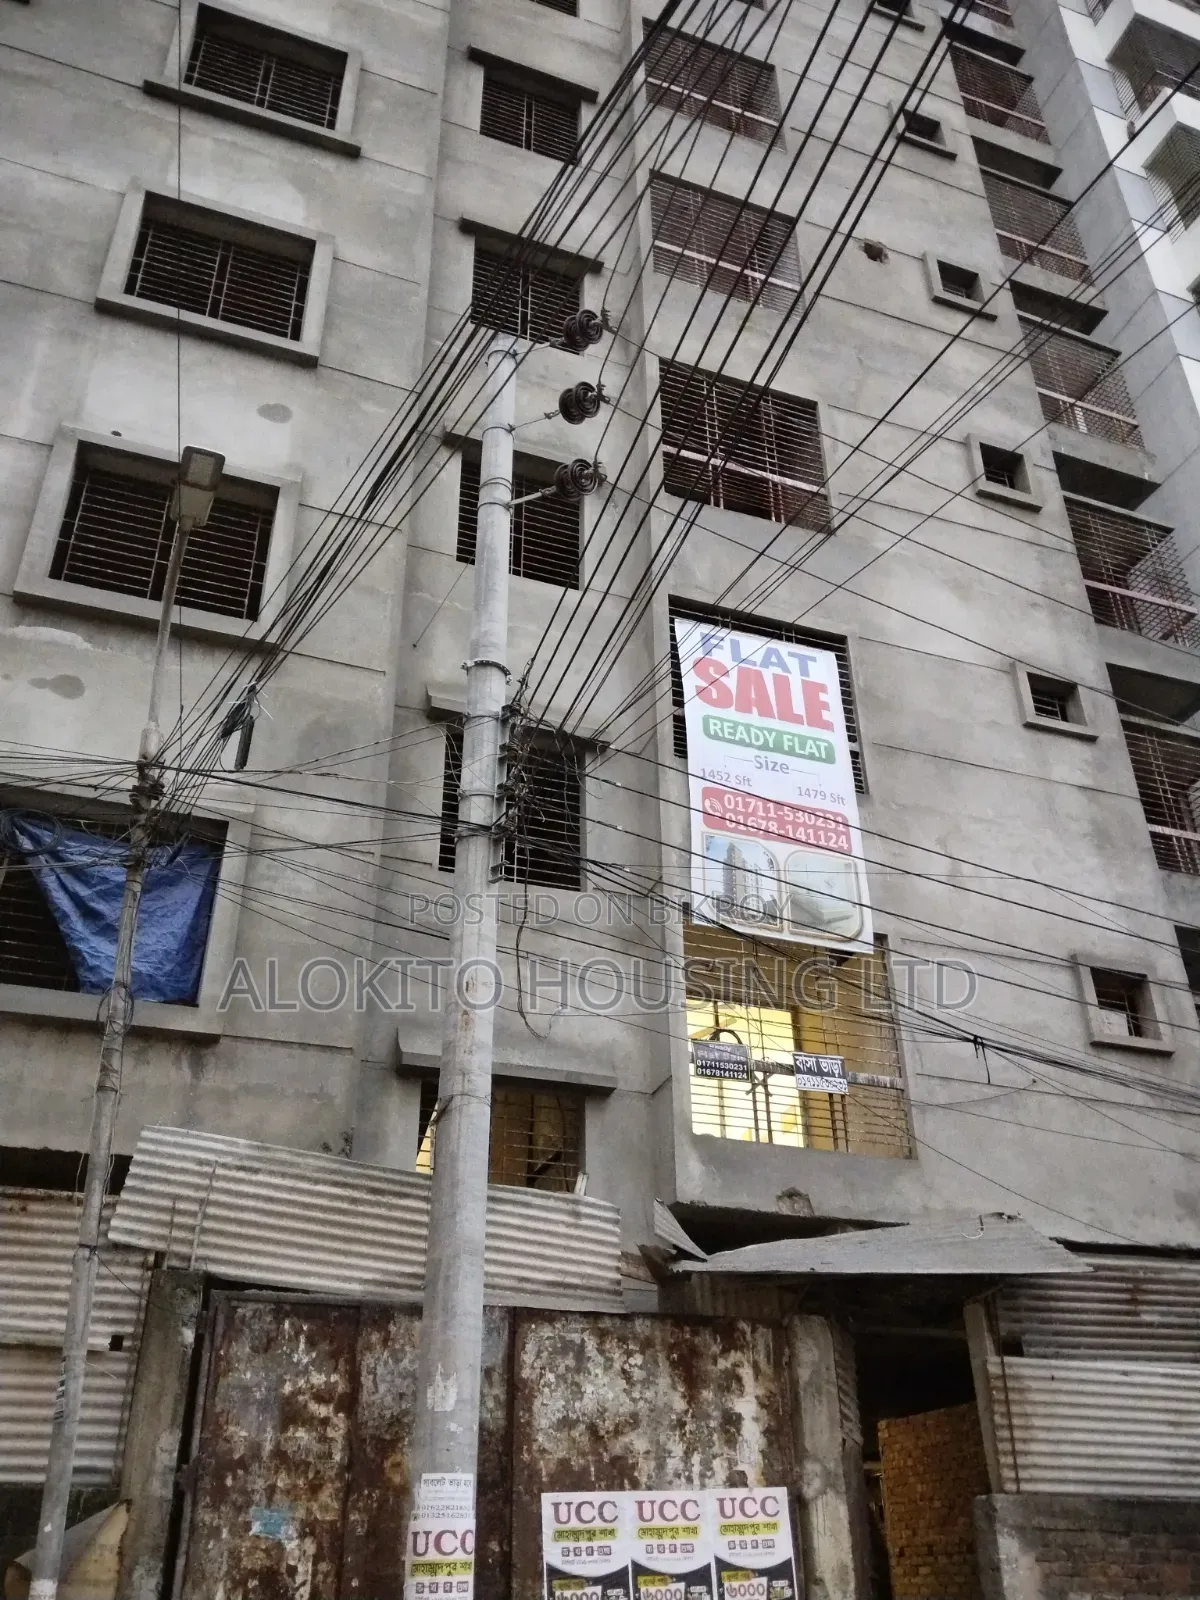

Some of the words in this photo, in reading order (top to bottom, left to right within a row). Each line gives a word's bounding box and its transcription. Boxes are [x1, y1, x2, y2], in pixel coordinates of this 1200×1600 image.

[699, 632, 817, 678] FLAT
[692, 657, 835, 733] SALE
[709, 718, 777, 748] READY
[783, 735, 829, 759] FLAT
[753, 755, 790, 775] Size
[701, 768, 732, 783] 1452
[735, 775, 752, 788] Sft
[797, 786, 827, 801] 1479
[830, 792, 846, 806] Sft
[724, 793, 847, 832] 01711-530231
[726, 812, 849, 850] 01678-141124
[696, 1059, 748, 1071] 01711530231
[696, 1068, 748, 1079] 01678141124
[551, 1500, 619, 1525] UCC
[635, 1499, 701, 1523] UCC
[716, 1495, 781, 1520] UCC
[411, 1529, 474, 1558] UCC
